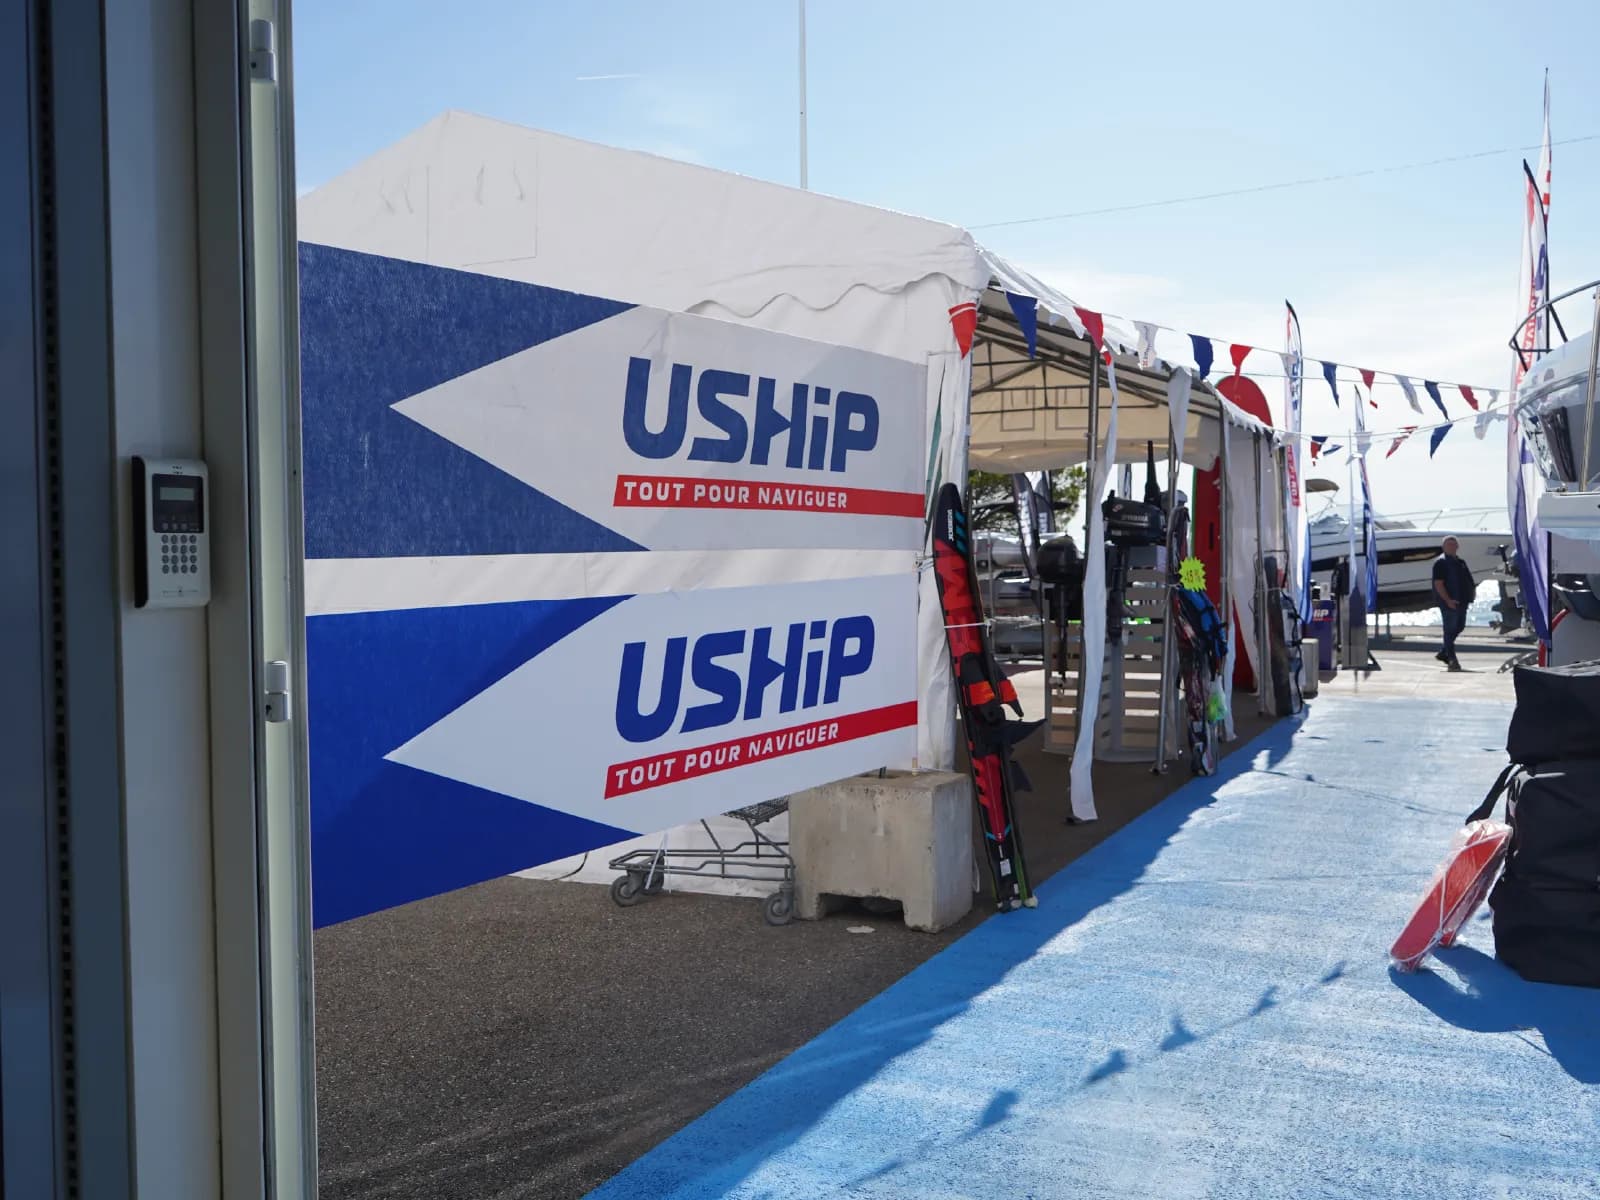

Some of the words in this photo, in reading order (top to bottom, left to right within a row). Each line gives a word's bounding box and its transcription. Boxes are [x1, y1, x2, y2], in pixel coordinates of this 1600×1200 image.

[623, 481, 685, 501] TOUT
[693, 484, 750, 504] POUR
[758, 487, 848, 509] NAVIGUER
[615, 758, 676, 789] TOUT
[684, 745, 741, 773] POUR
[748, 722, 839, 758] NAVIGUER
